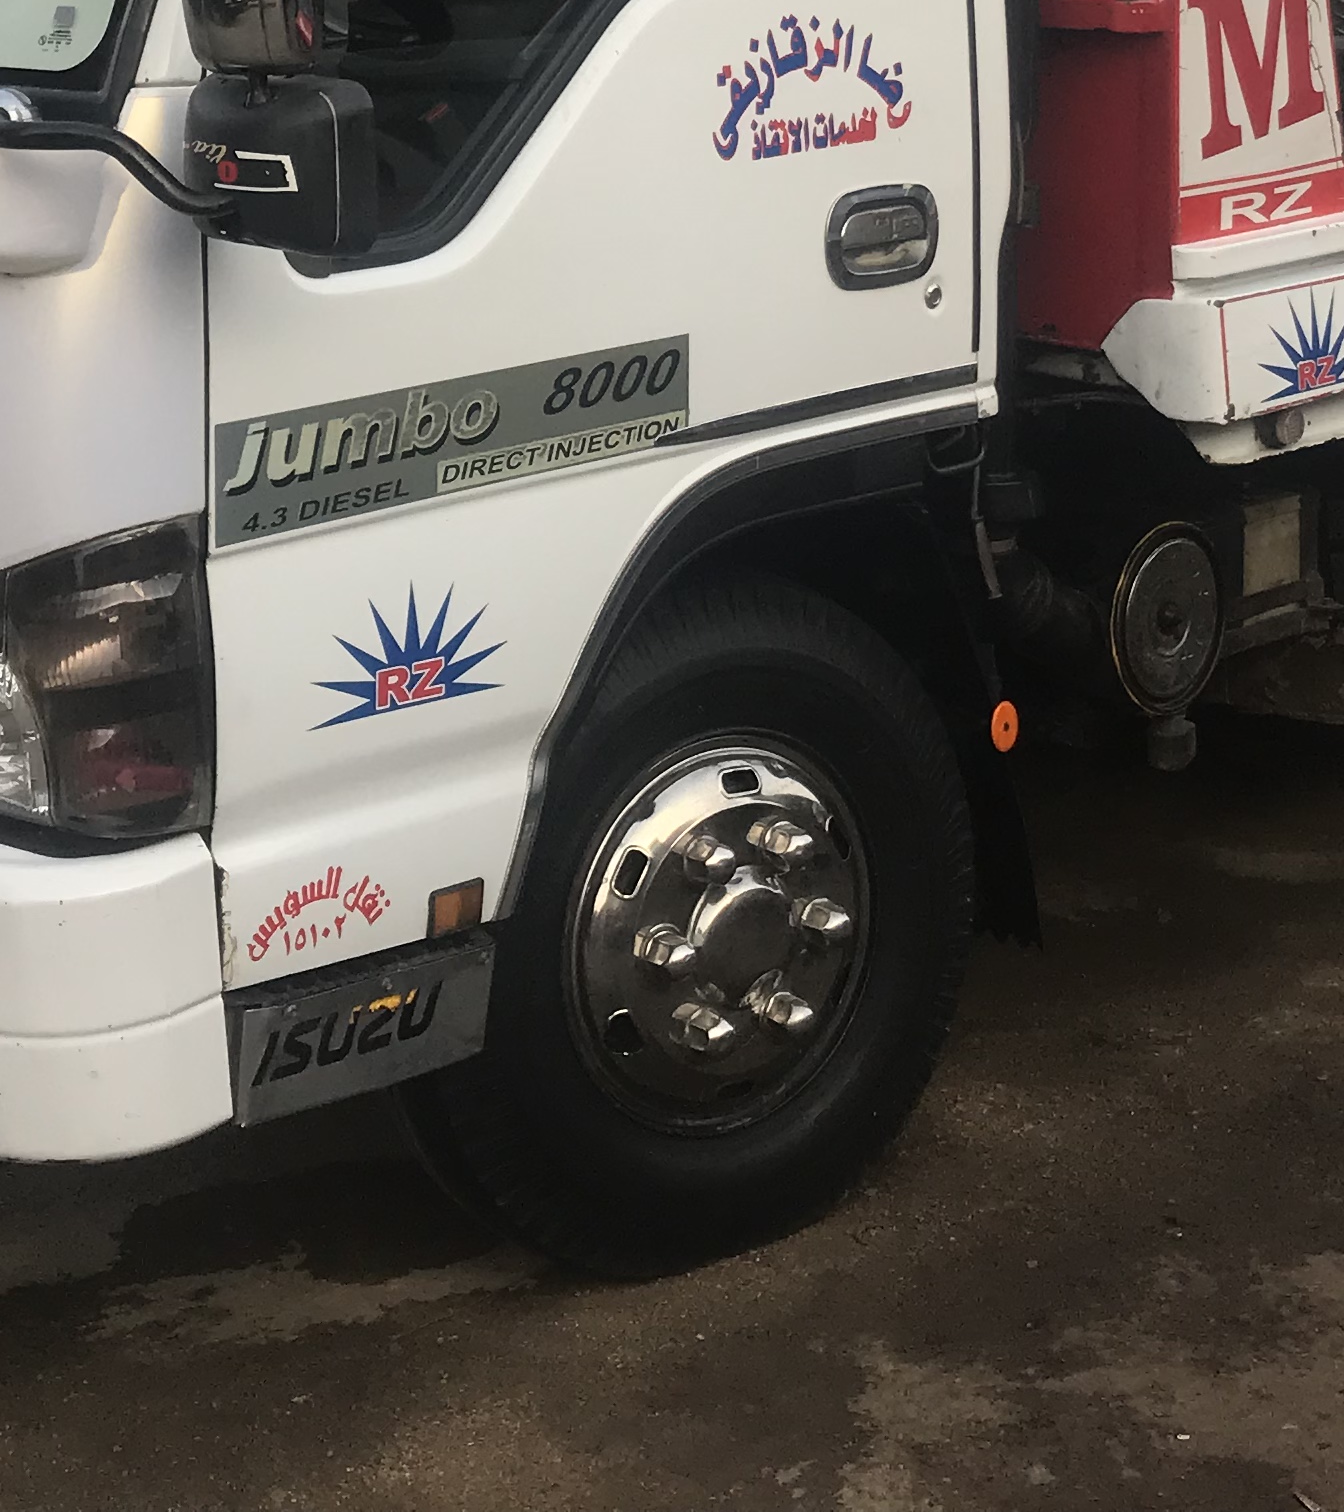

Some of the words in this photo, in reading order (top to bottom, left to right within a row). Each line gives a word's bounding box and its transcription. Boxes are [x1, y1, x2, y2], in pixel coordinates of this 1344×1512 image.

[1219, 180, 1313, 232] RZ
[1297, 354, 1337, 391] RZ
[223, 388, 501, 497] jumbo
[543, 348, 681, 416] 8000
[442, 446, 543, 484] DIRECT
[546, 417, 680, 463] INJECTION
[242, 506, 288, 534] 4.3
[298, 478, 410, 523] DIESEL
[374, 655, 446, 711] RZ
[247, 866, 343, 962] السويس
[343, 875, 391, 926] نقل
[249, 980, 443, 1088] ISUZU
